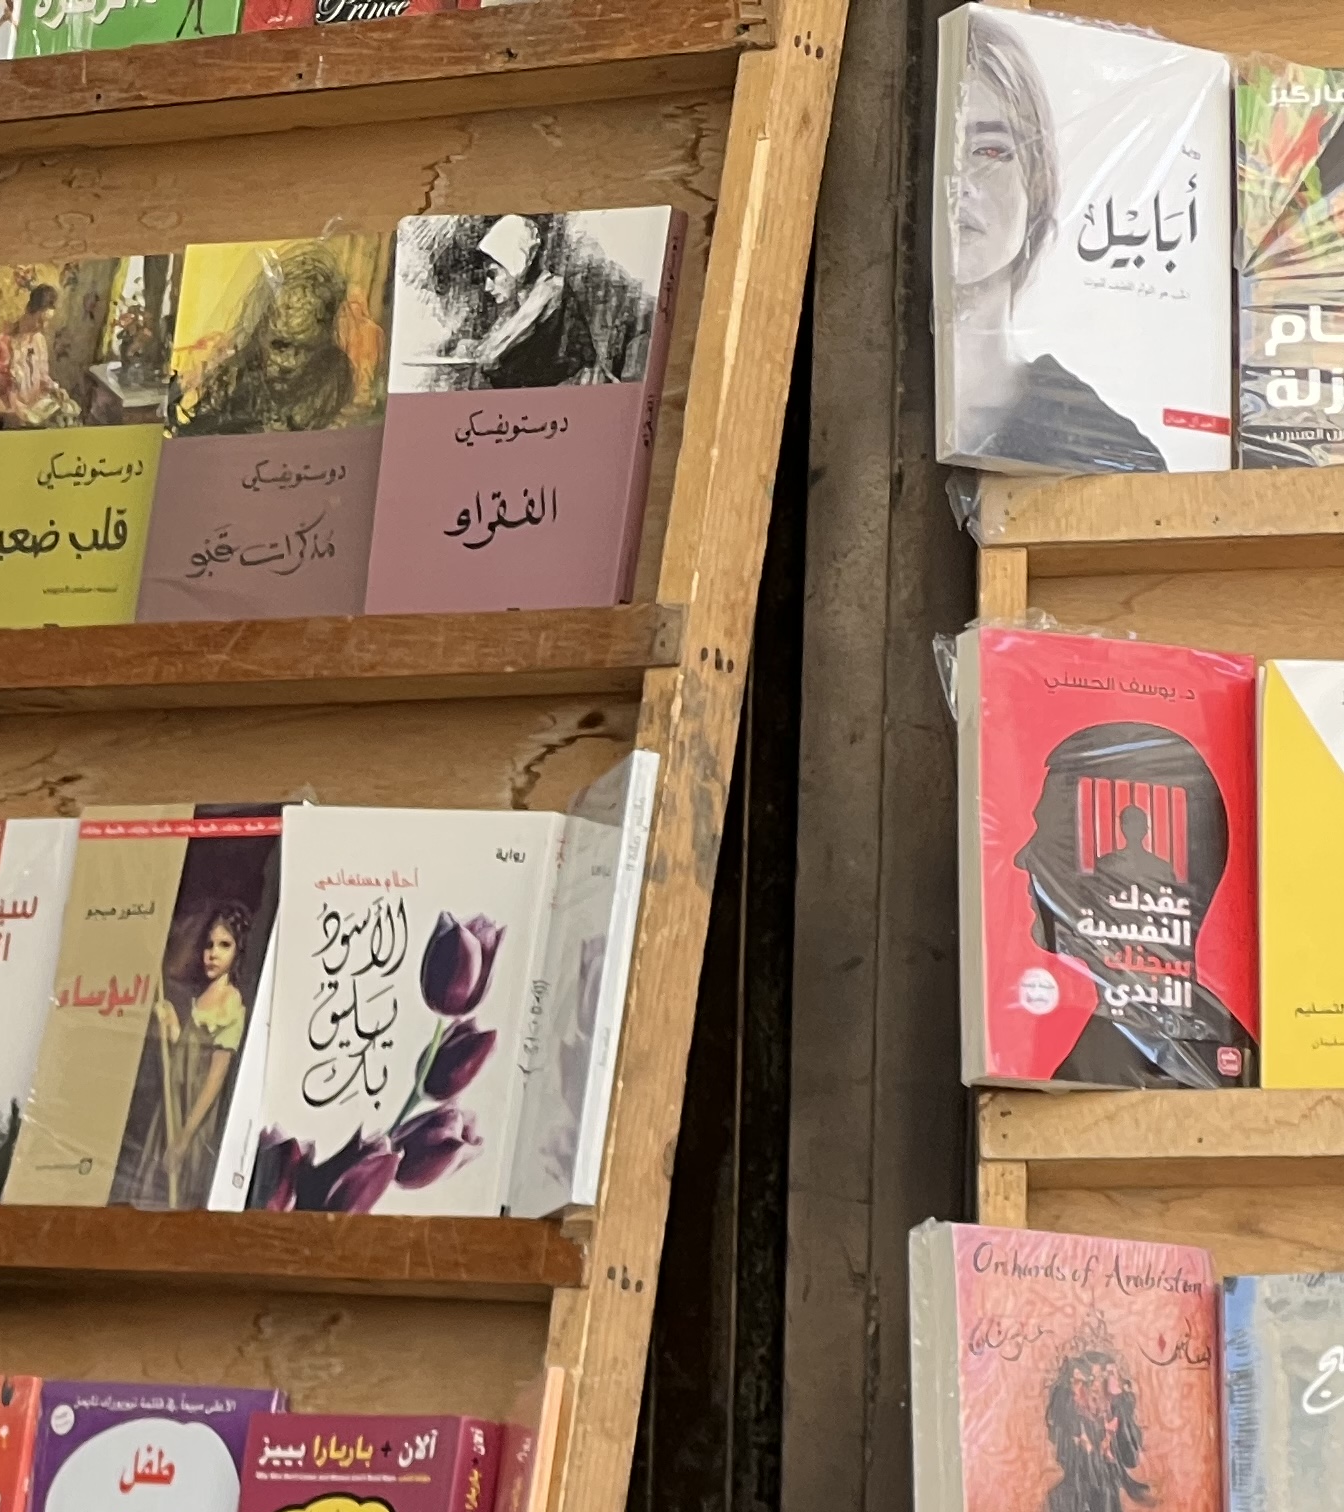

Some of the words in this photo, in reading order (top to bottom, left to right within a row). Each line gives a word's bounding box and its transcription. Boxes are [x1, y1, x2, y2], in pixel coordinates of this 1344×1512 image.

[316, 0, 411, 25] Prince
[453, 412, 569, 444] دوستويفسكي
[36, 452, 144, 488] دوستويفسكي
[241, 459, 347, 491] دوستويفسكي
[68, 506, 129, 555] قلب
[1044, 672, 1115, 695] الحسني
[1120, 681, 1176, 704] يوسف
[495, 848, 526, 864] رواية
[1108, 884, 1192, 916] عقدك
[1076, 908, 1192, 948] النفسية
[57, 973, 151, 1018] البؤساء
[312, 1432, 374, 1469] باربارا
[397, 1428, 439, 1469] آلان
[119, 1443, 176, 1495] طفل
